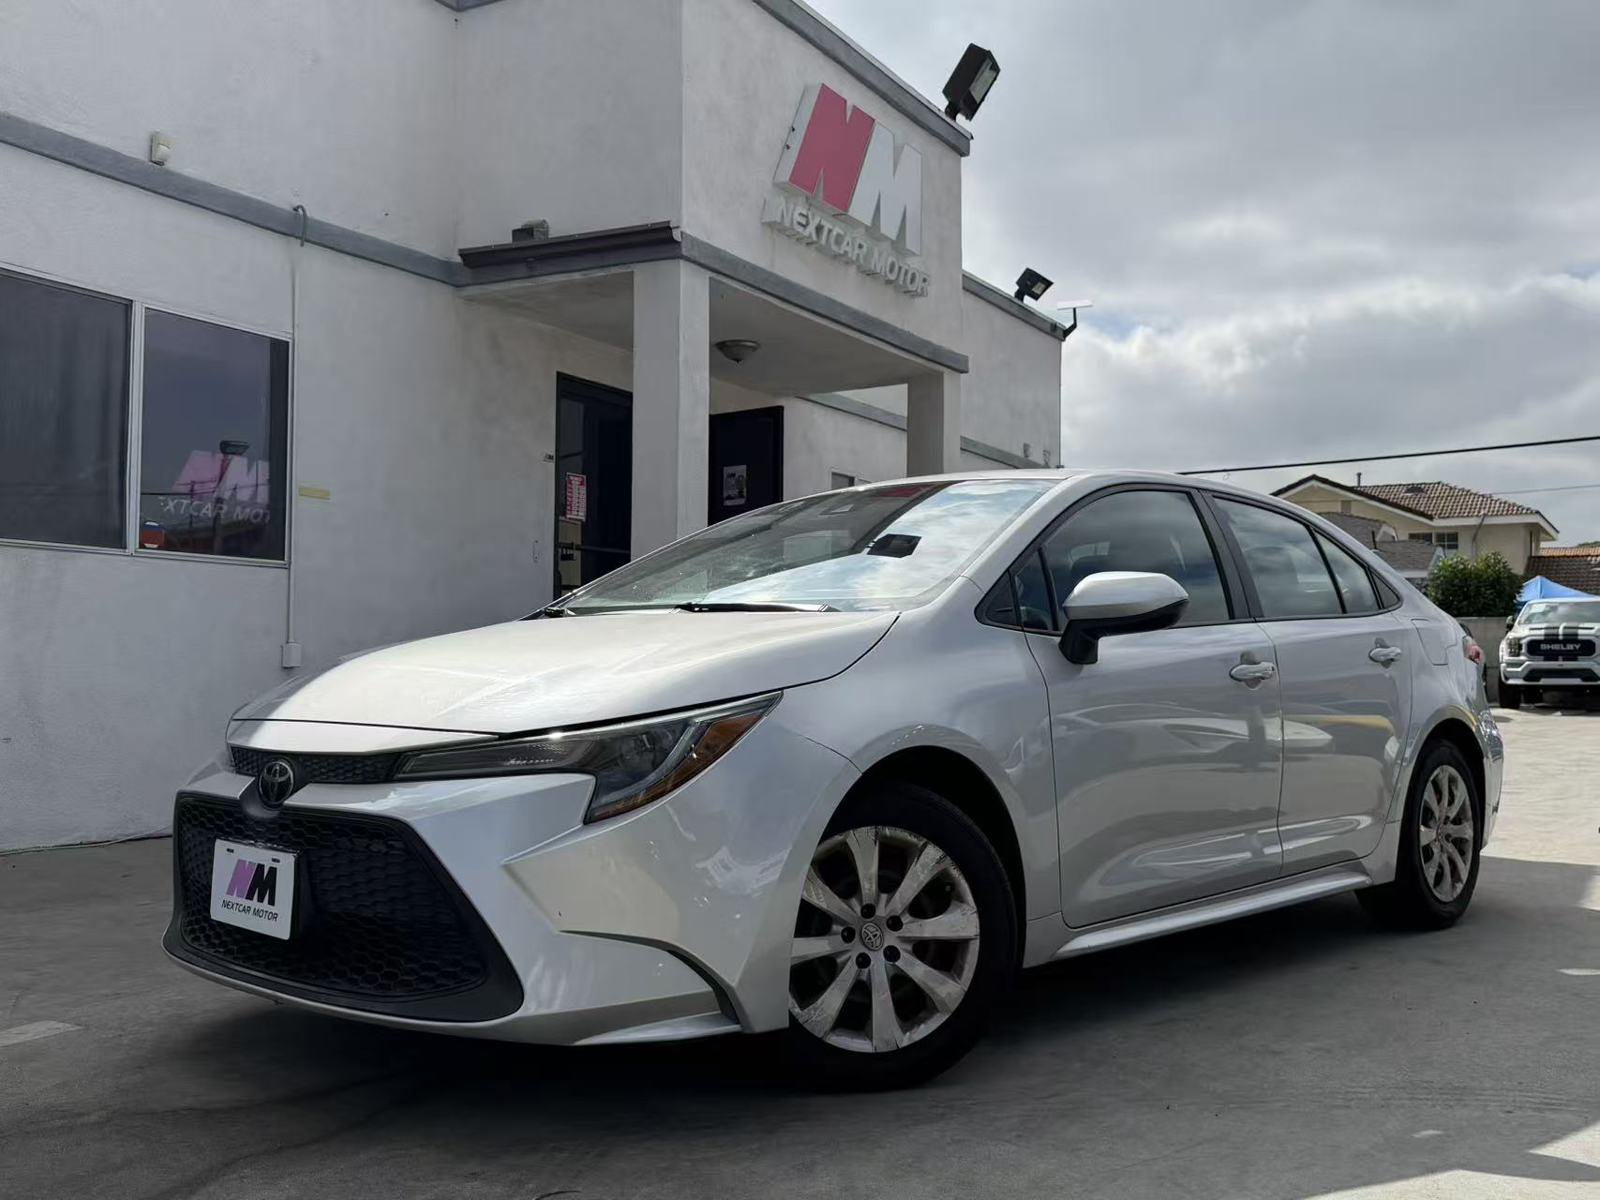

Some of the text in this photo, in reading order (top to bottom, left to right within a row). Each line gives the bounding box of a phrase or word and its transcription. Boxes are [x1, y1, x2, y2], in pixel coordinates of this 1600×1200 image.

[774, 198, 930, 294] NEXTCAR MOTOR
[221, 899, 279, 922] NEXTCAR MOTOR
